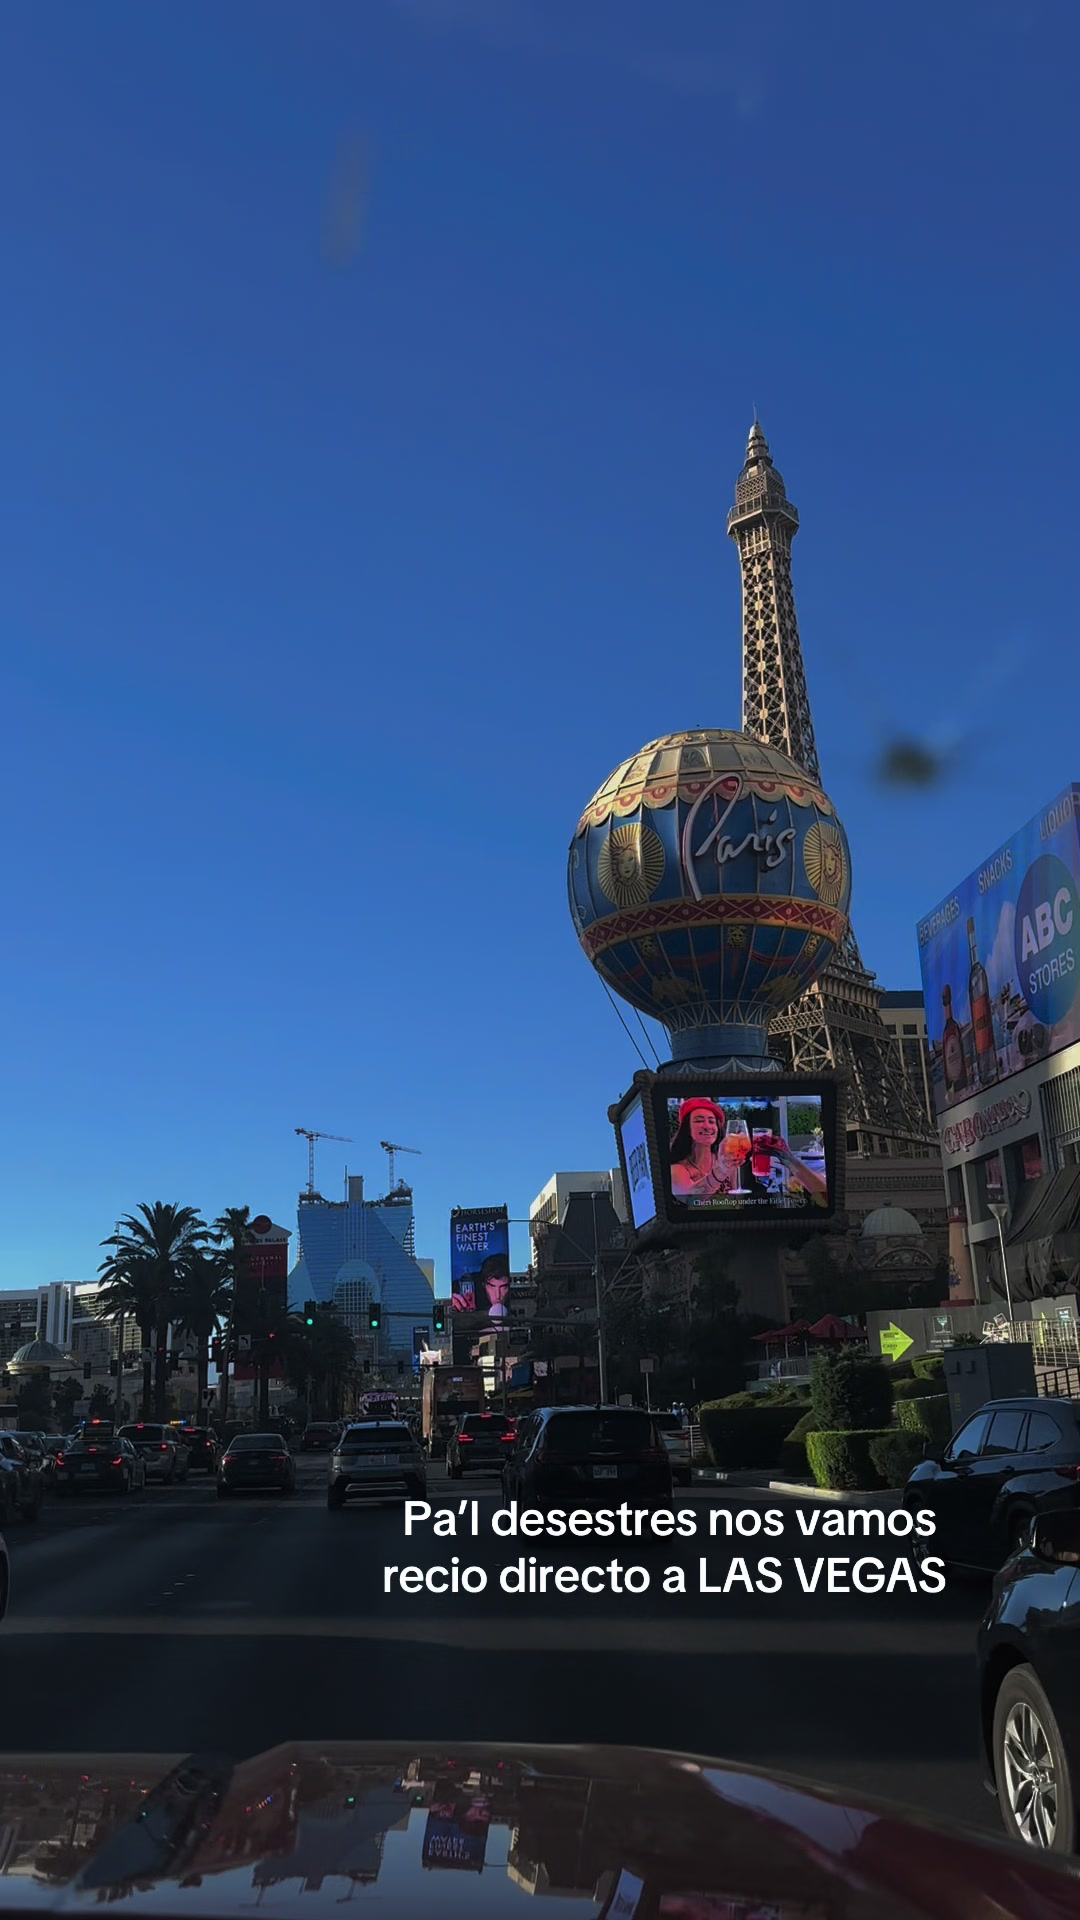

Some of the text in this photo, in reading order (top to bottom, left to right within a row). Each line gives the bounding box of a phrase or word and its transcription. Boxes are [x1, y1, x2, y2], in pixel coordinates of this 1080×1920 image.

[682, 772, 797, 901] Paris
[920, 896, 960, 948] BEVERAGES
[978, 848, 1013, 894] SNACKS
[1022, 887, 1073, 963] ABC
[1029, 948, 1075, 994] STORES
[456, 1221, 495, 1233] EARTH'S
[456, 1232, 489, 1243] FINEST
[456, 1241, 489, 1252] WATER
